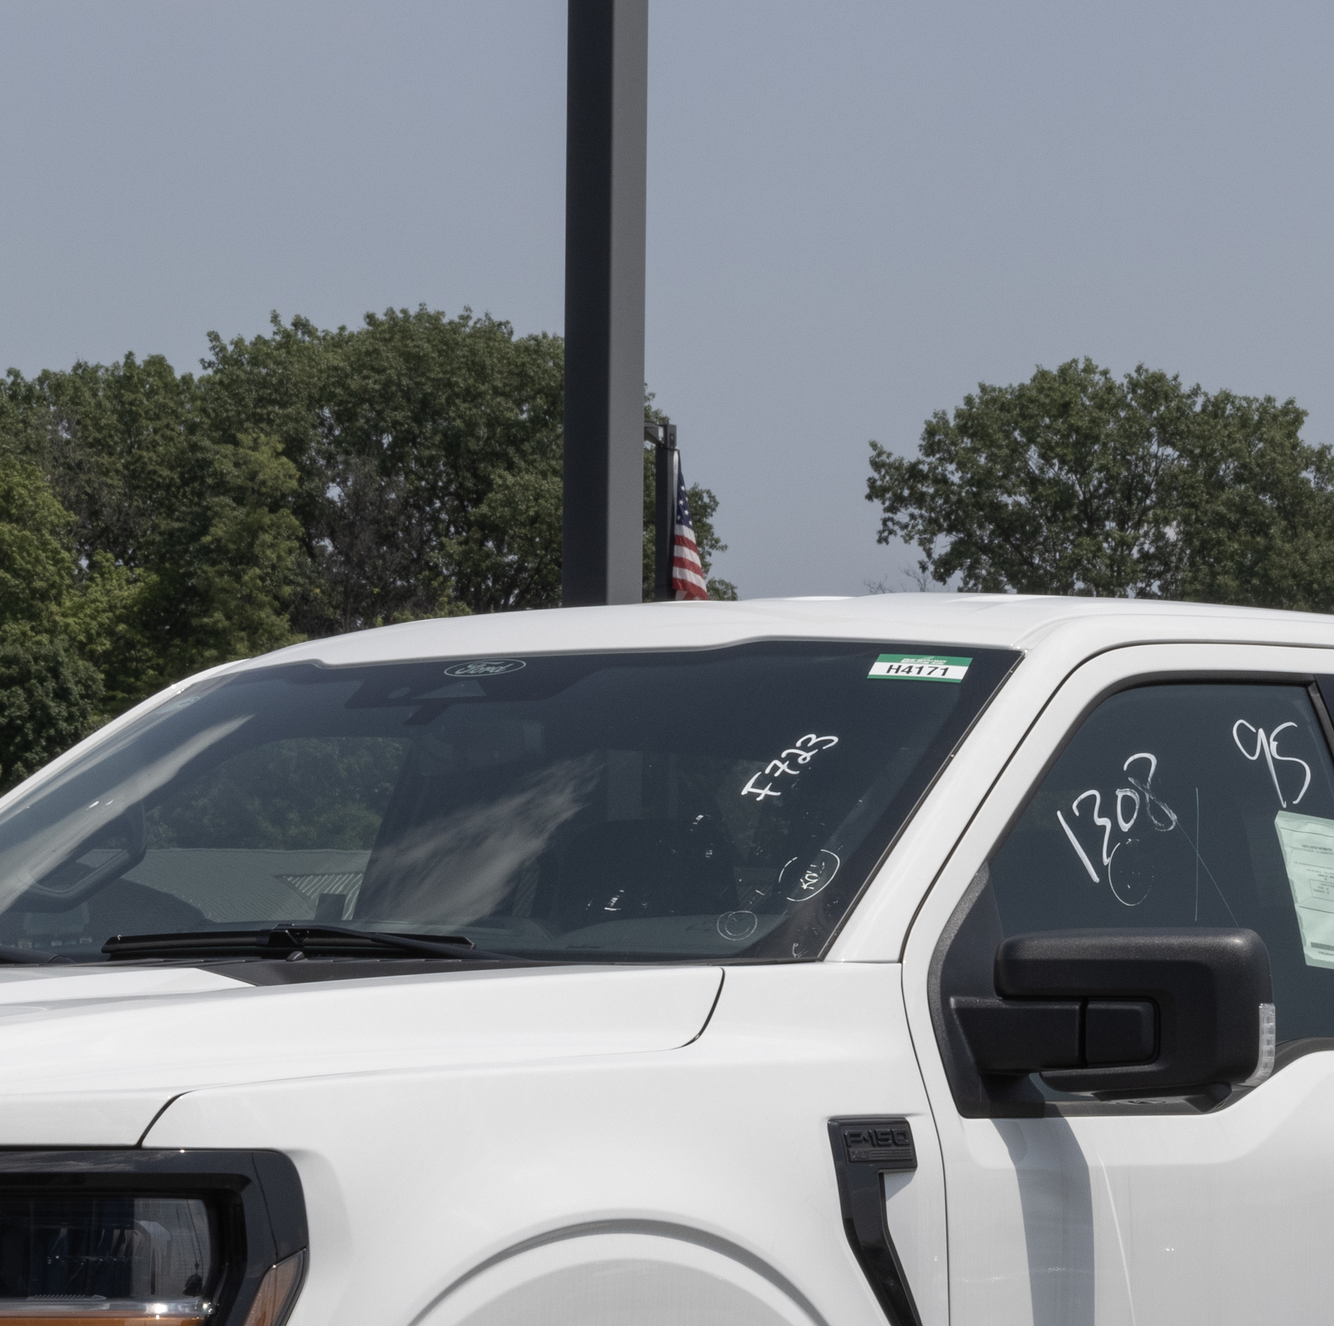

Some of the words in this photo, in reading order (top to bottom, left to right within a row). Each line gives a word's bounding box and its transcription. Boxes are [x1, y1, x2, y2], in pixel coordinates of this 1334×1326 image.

[456, 661, 516, 676] Ford
[885, 664, 950, 677] H4171
[1233, 719, 1311, 809] 95
[843, 1128, 912, 1148] F-150
